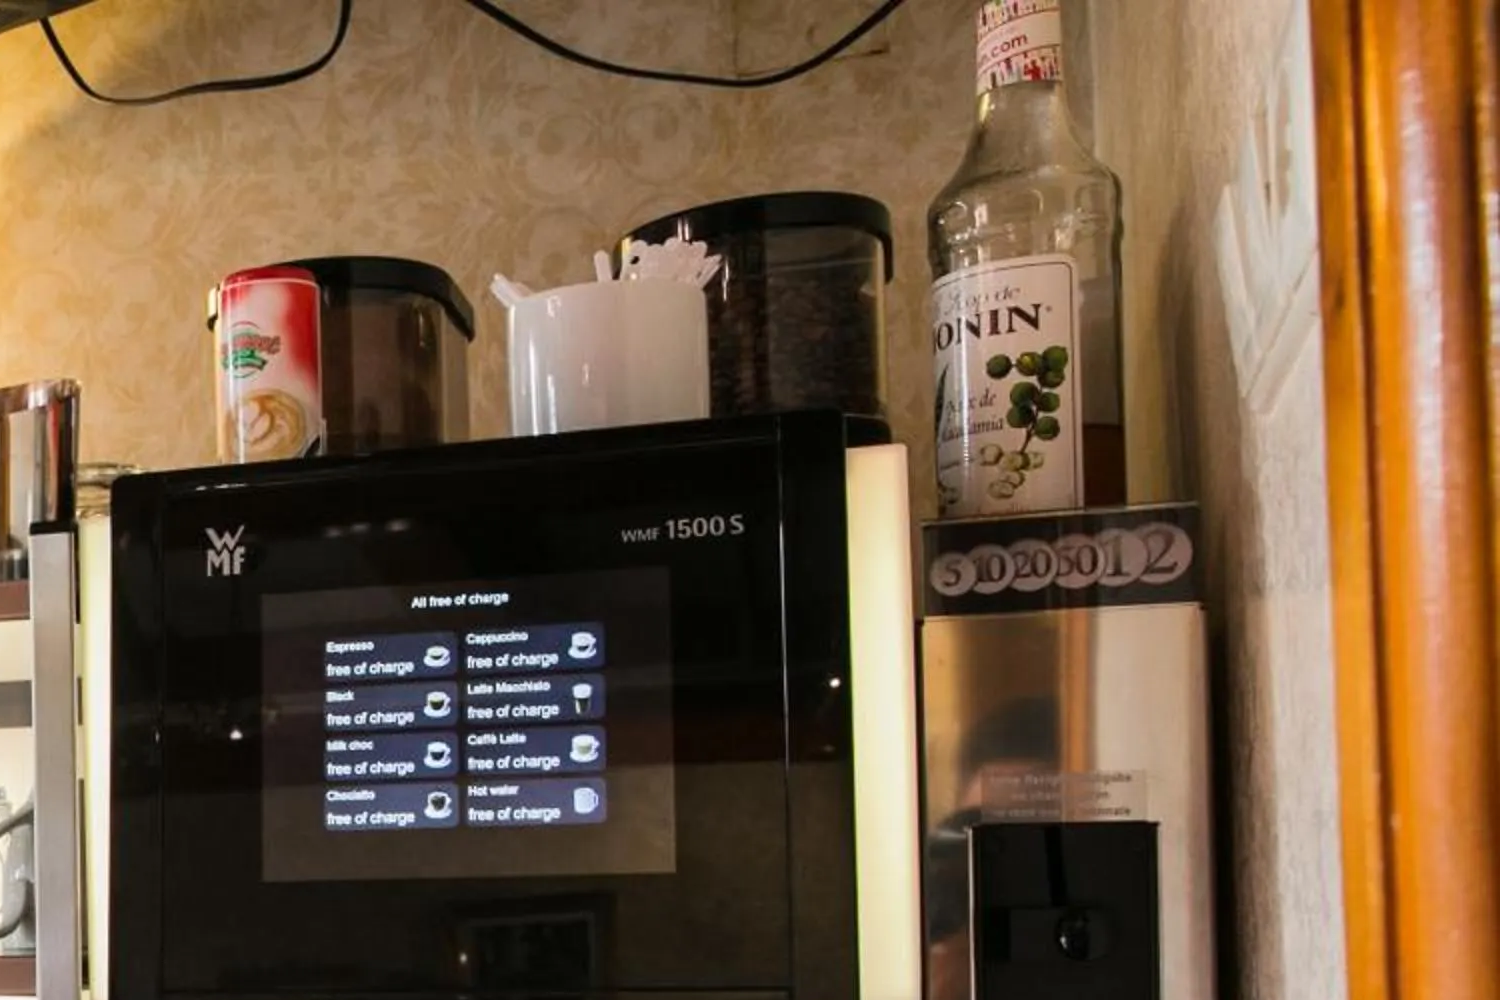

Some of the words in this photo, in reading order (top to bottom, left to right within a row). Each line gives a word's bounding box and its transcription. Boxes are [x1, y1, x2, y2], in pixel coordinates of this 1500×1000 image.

[933, 303, 1041, 353] ONIN
[621, 527, 660, 543] WMF
[411, 596, 427, 608] All
[429, 595, 452, 607] free
[454, 593, 467, 605] of
[468, 592, 509, 606] charge
[466, 630, 529, 645] Cappuccino
[326, 641, 375, 654] Espresso
[467, 655, 493, 668] free
[495, 653, 510, 667] of
[511, 652, 559, 668] charge
[326, 663, 351, 676] free
[353, 662, 367, 675] of
[369, 661, 414, 676] charge
[467, 683, 494, 695] Latte
[495, 680, 551, 693] Macchiato
[327, 713, 352, 726] free
[353, 711, 368, 725] of
[369, 711, 415, 726] charge
[467, 706, 493, 719] free
[496, 704, 510, 717] of
[512, 703, 560, 719] charge
[499, 733, 527, 744] Latte
[327, 762, 352, 775] free
[354, 761, 368, 774] of
[369, 760, 415, 776] charge
[467, 756, 494, 770] free
[496, 755, 511, 769] of
[512, 754, 561, 771] charge
[467, 785, 488, 797] Hot
[489, 784, 519, 796] water
[327, 812, 352, 825] free
[354, 811, 368, 824] of
[369, 811, 416, 827] charge
[468, 807, 495, 821] free
[497, 806, 512, 820] of
[513, 806, 562, 823] charge
